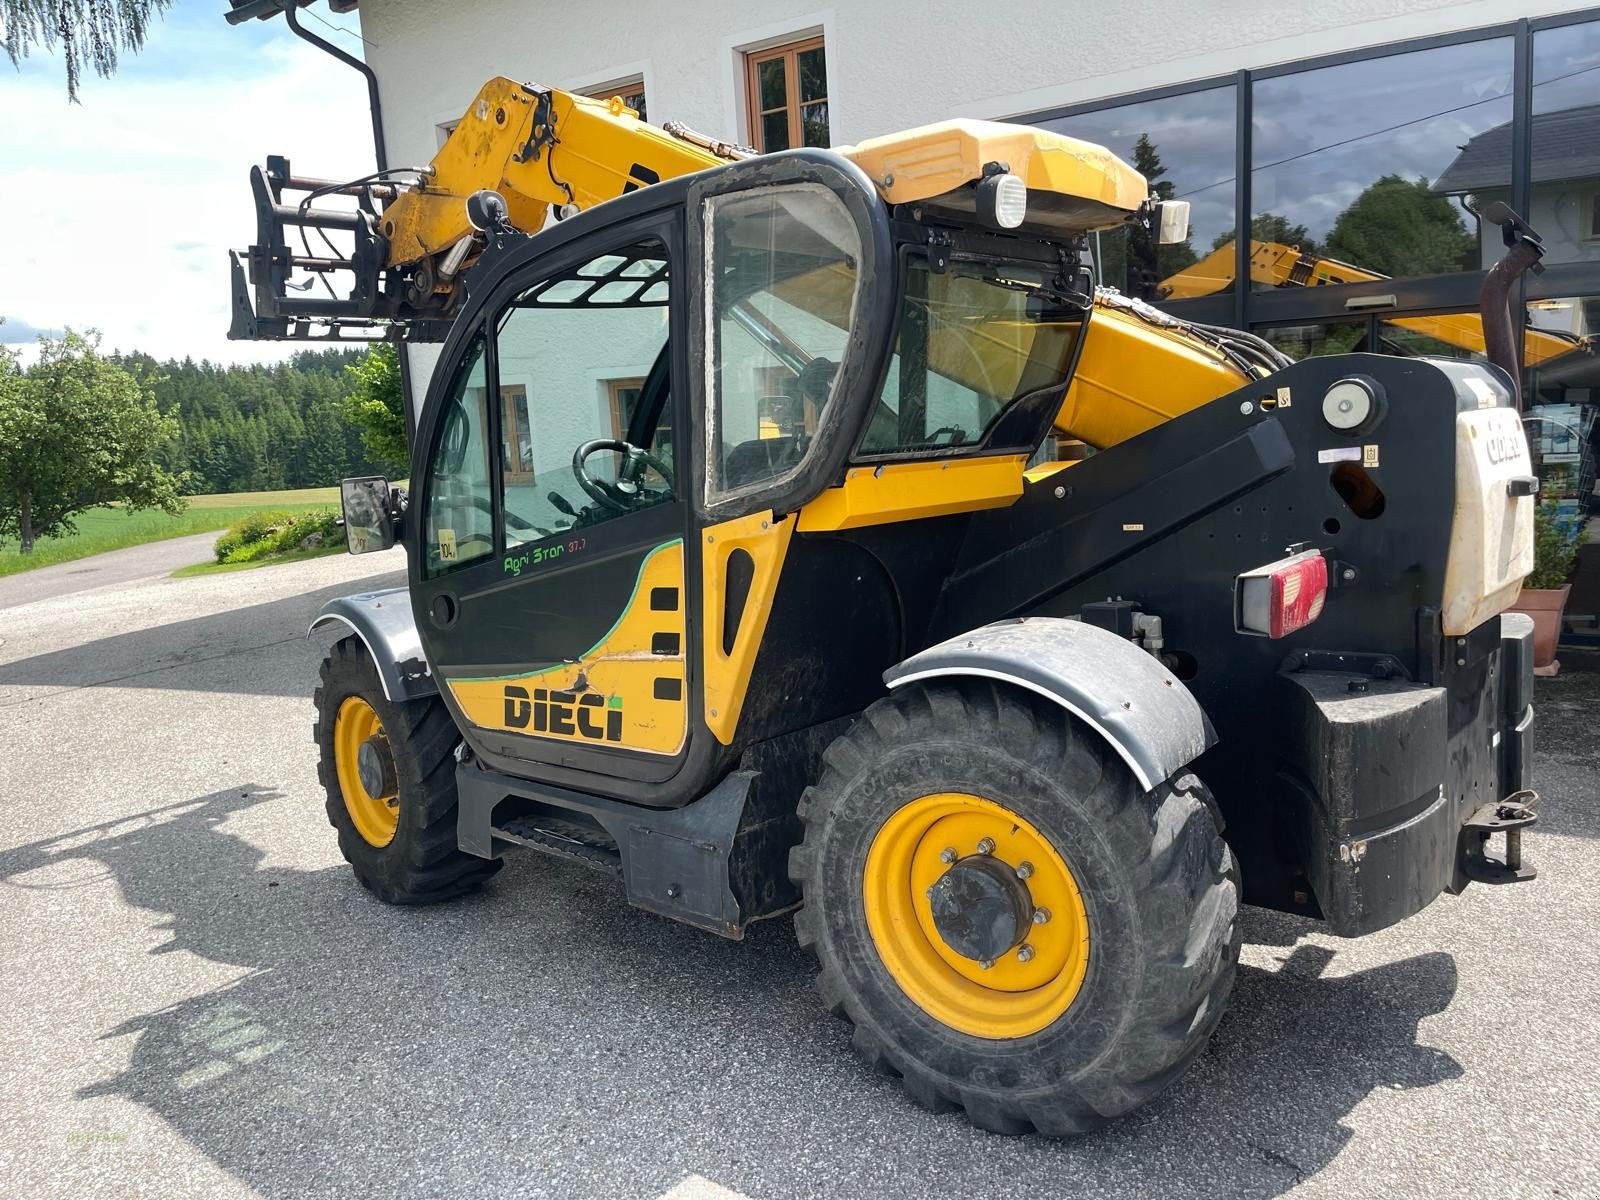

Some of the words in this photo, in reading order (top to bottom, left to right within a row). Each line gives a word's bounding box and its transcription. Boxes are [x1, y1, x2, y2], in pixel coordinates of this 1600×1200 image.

[504, 552, 529, 576] Agri
[568, 539, 586, 553] 37.7
[504, 685, 623, 742] DIECI
